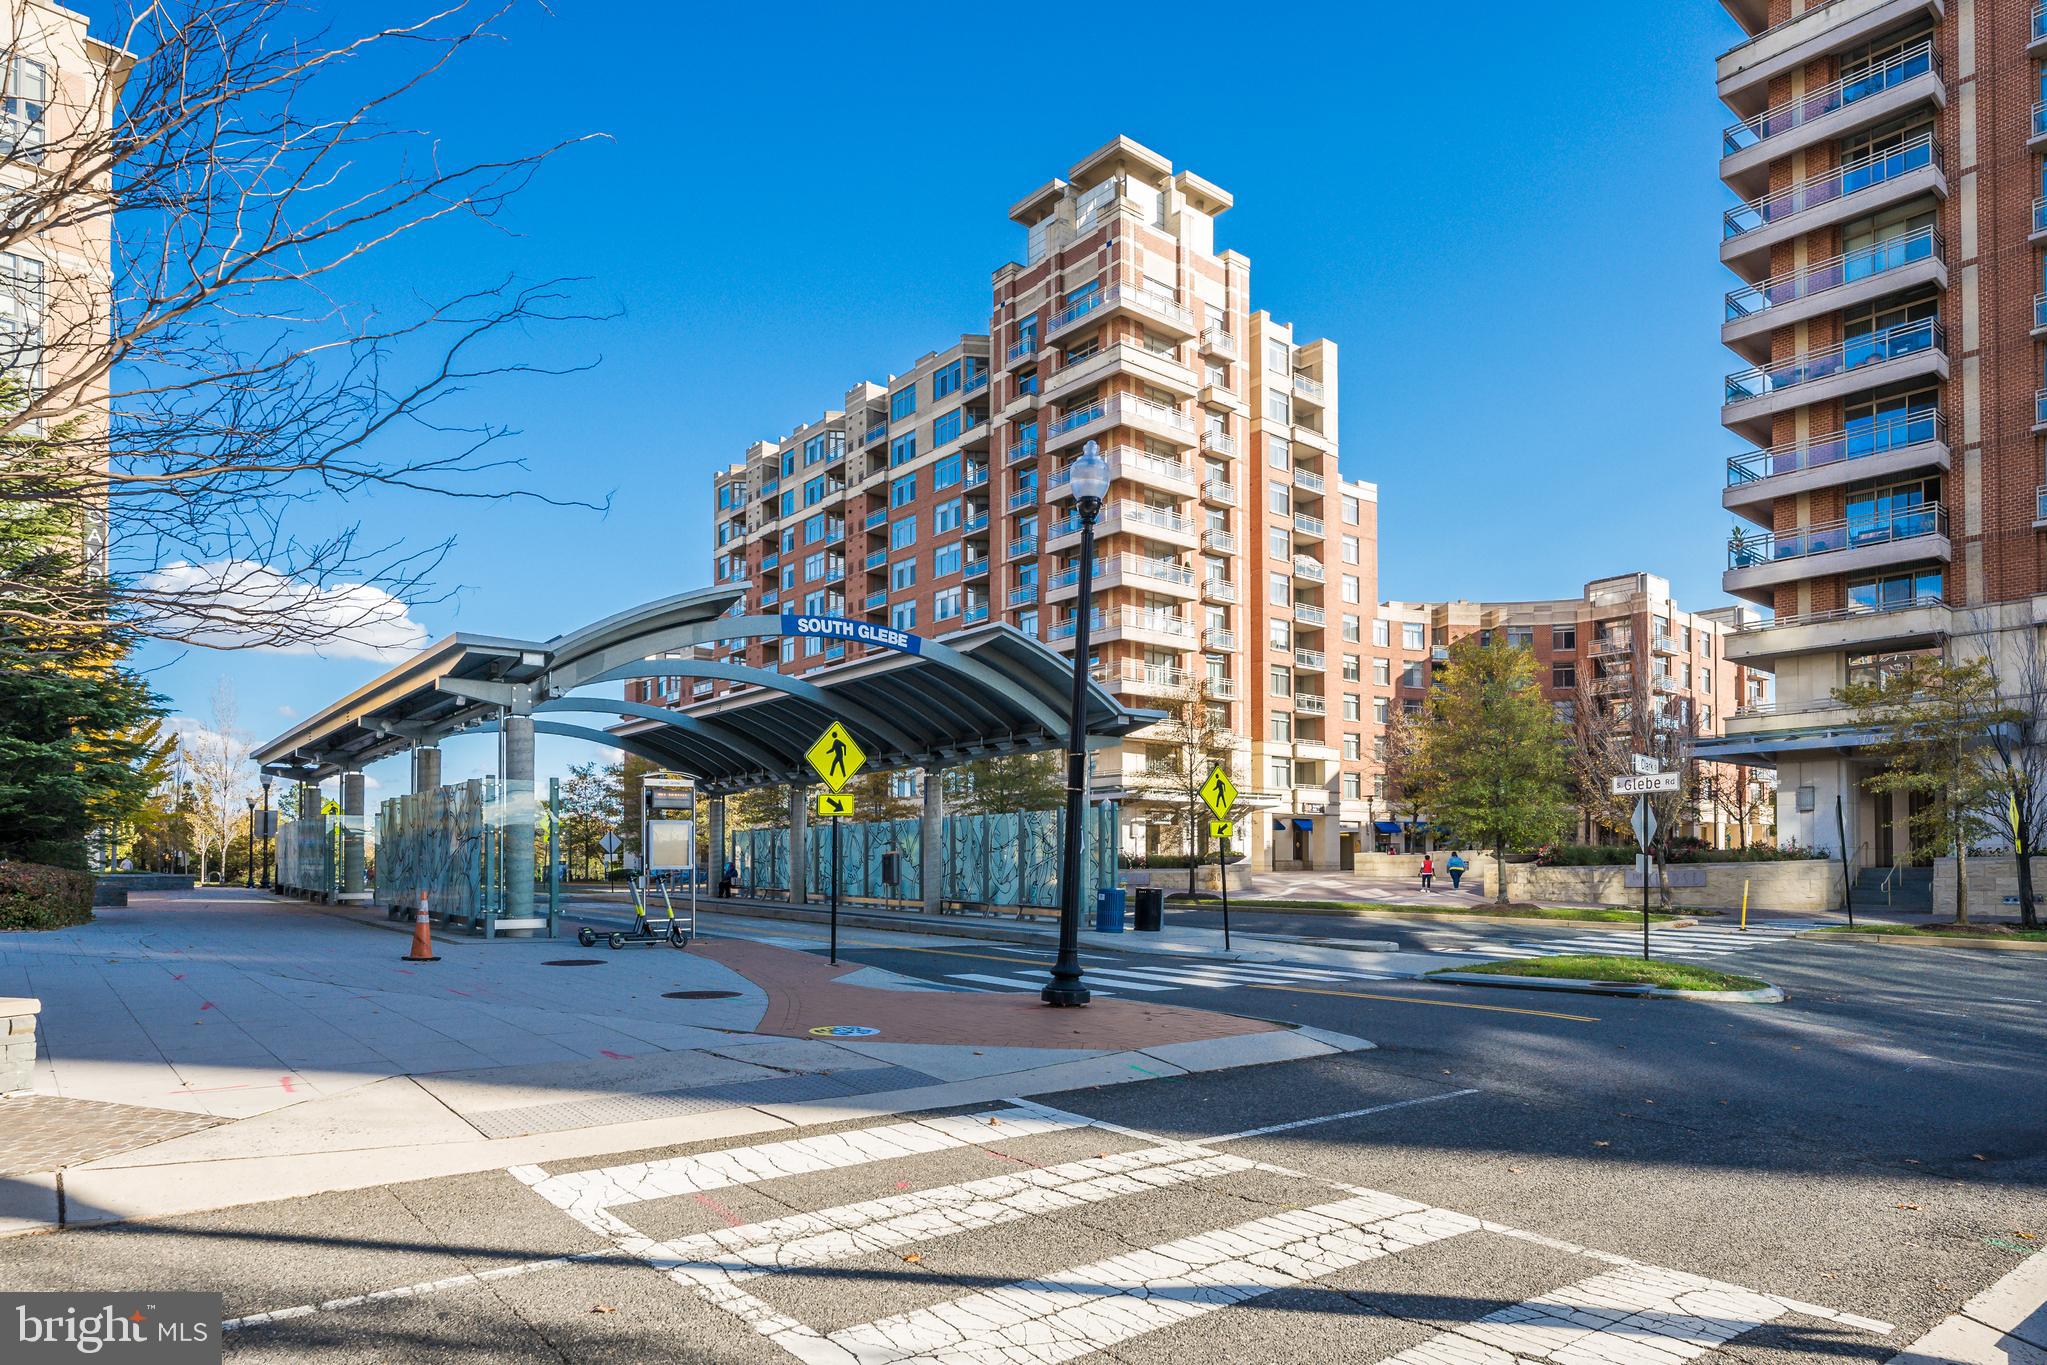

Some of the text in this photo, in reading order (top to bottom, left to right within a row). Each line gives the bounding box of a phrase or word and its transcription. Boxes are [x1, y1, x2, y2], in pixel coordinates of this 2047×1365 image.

[797, 618, 909, 648] SOUTH GLEBE
[1624, 777, 1661, 791] Glebe
[1665, 778, 1675, 786] Rd
